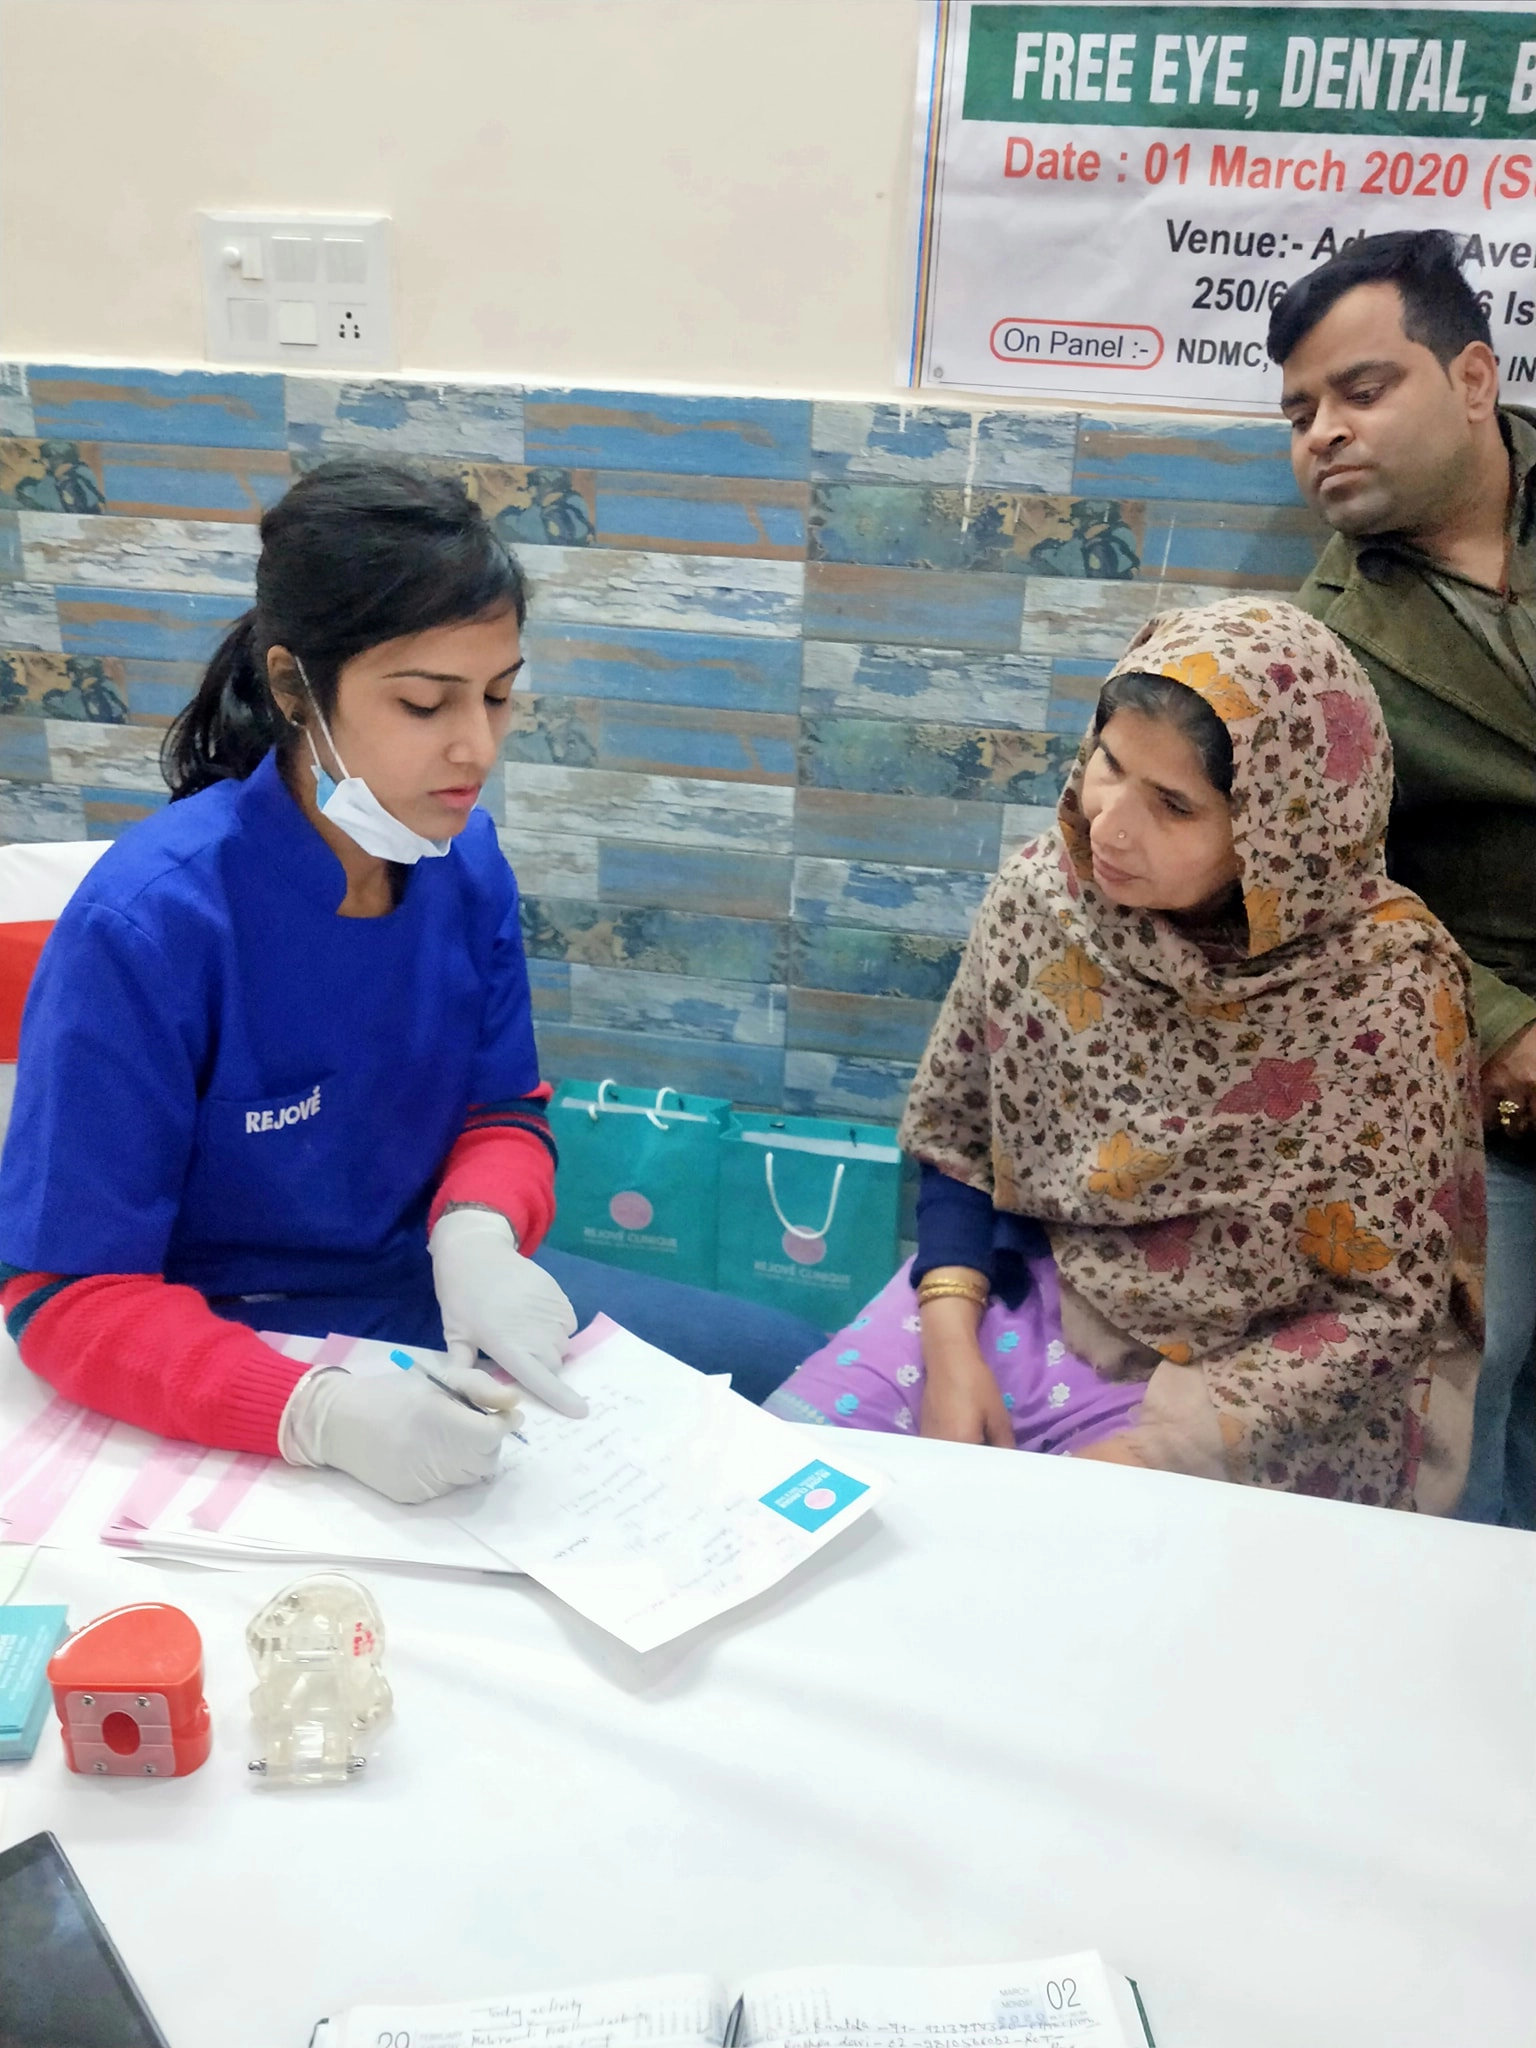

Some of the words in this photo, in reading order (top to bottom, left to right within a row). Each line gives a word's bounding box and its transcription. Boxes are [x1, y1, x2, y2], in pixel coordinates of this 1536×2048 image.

[1012, 31, 1137, 102] FREE
[1149, 34, 1259, 119] EYE,
[1279, 36, 1487, 126] DENTAL,
[1004, 136, 1101, 182] Date
[1144, 141, 1191, 185] 01
[1209, 144, 1346, 192] March
[1360, 150, 1469, 197] 2020
[1483, 153, 1536, 210] (S
[1166, 219, 1303, 259] Venue:-
[1458, 233, 1536, 269] Ave
[1003, 328, 1040, 353] On
[1050, 331, 1123, 358] Panel
[1176, 338, 1269, 372] NDMC,
[245, 1085, 321, 1134] REJOVÉ
[1046, 1978, 1082, 2010] 02
